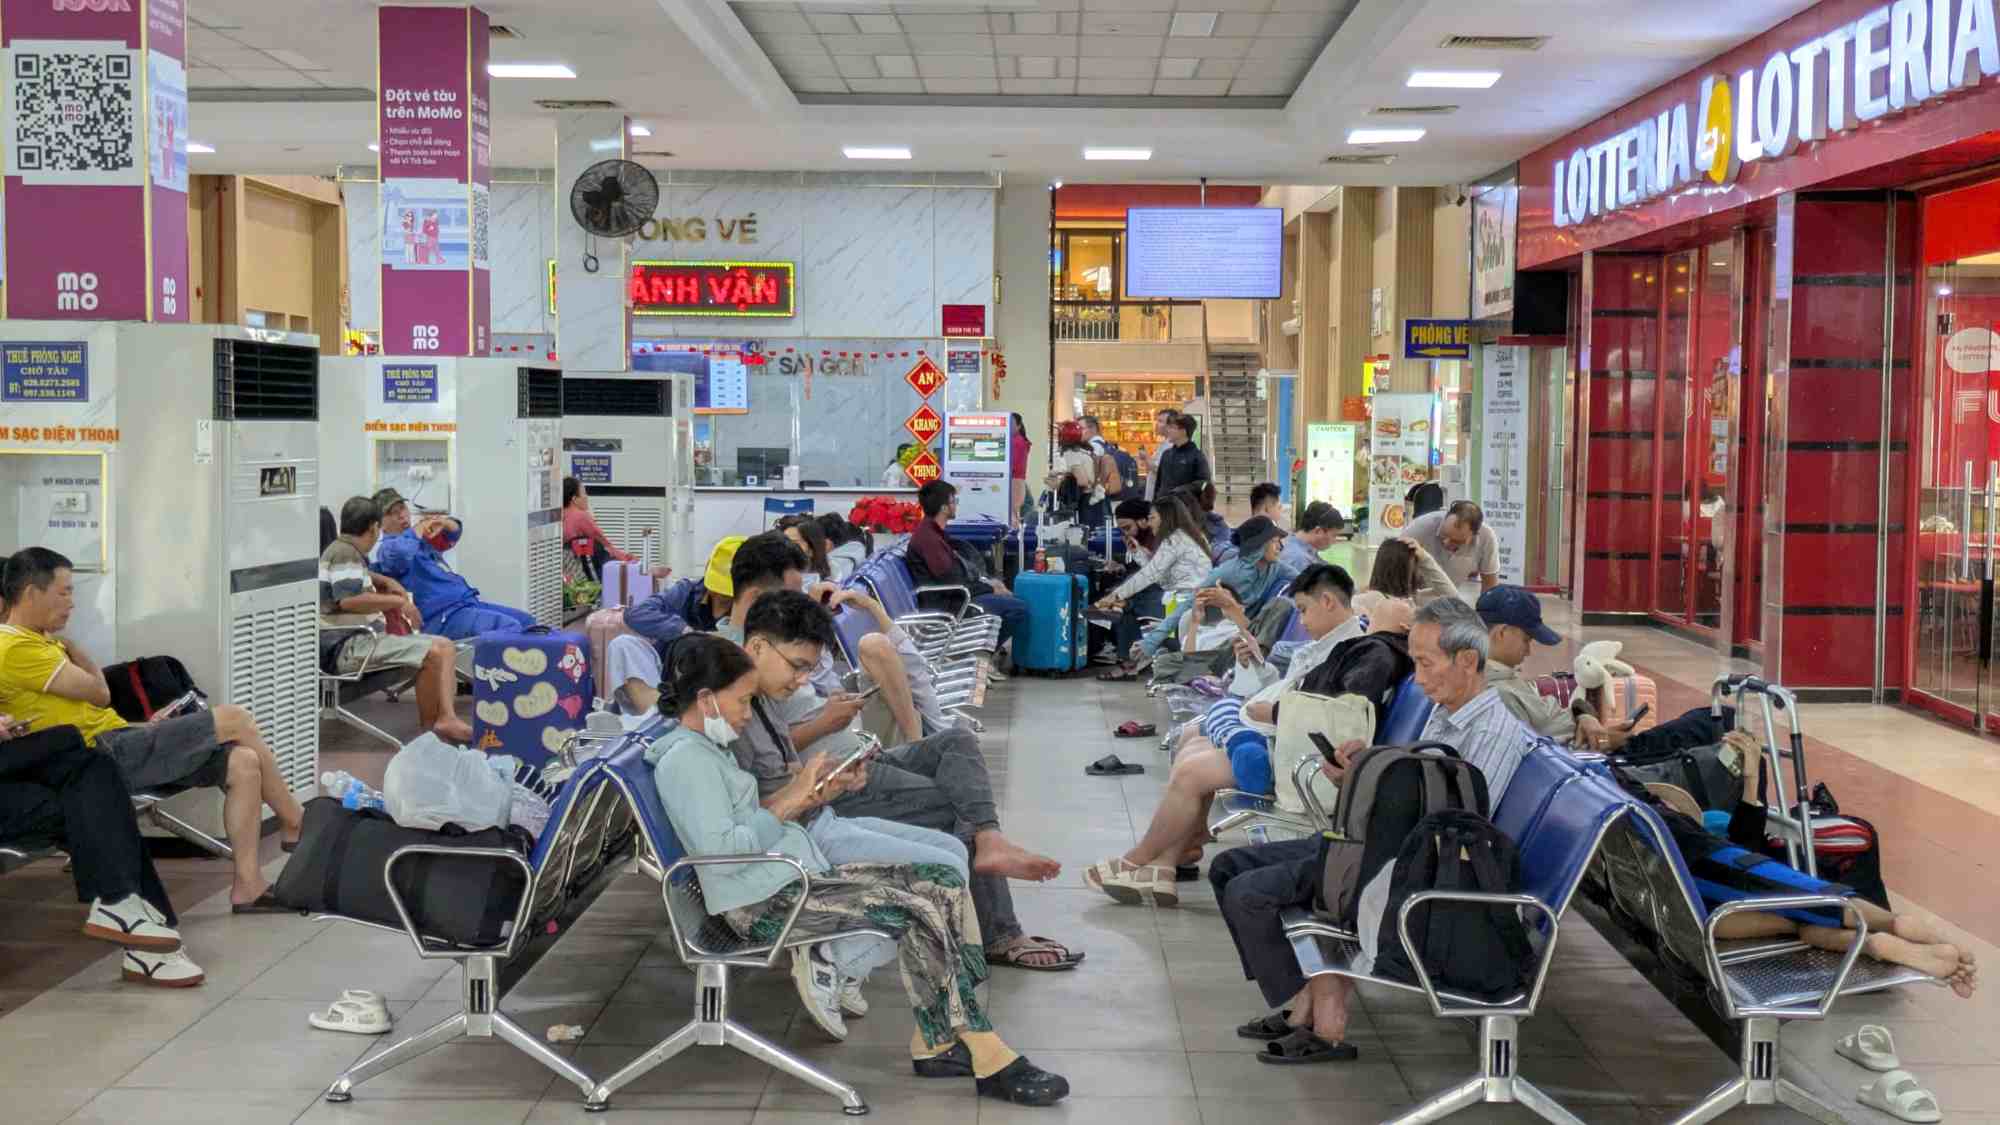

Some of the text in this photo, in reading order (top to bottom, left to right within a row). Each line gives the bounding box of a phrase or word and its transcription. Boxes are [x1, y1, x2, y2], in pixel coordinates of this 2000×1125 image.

[1737, 0, 2000, 163] LOTTERIA
[385, 87, 457, 103] Đặt vé tàu
[386, 105, 463, 119] trên MoMo
[1553, 103, 1690, 228] LOTTERIA
[716, 212, 757, 243] VÉ
[1410, 322, 1452, 344] PHÒNG
[918, 372, 934, 385] AN
[14, 427, 39, 443] SẠC
[43, 425, 77, 443] ĐIỆN
[79, 427, 120, 443] THOẠI
